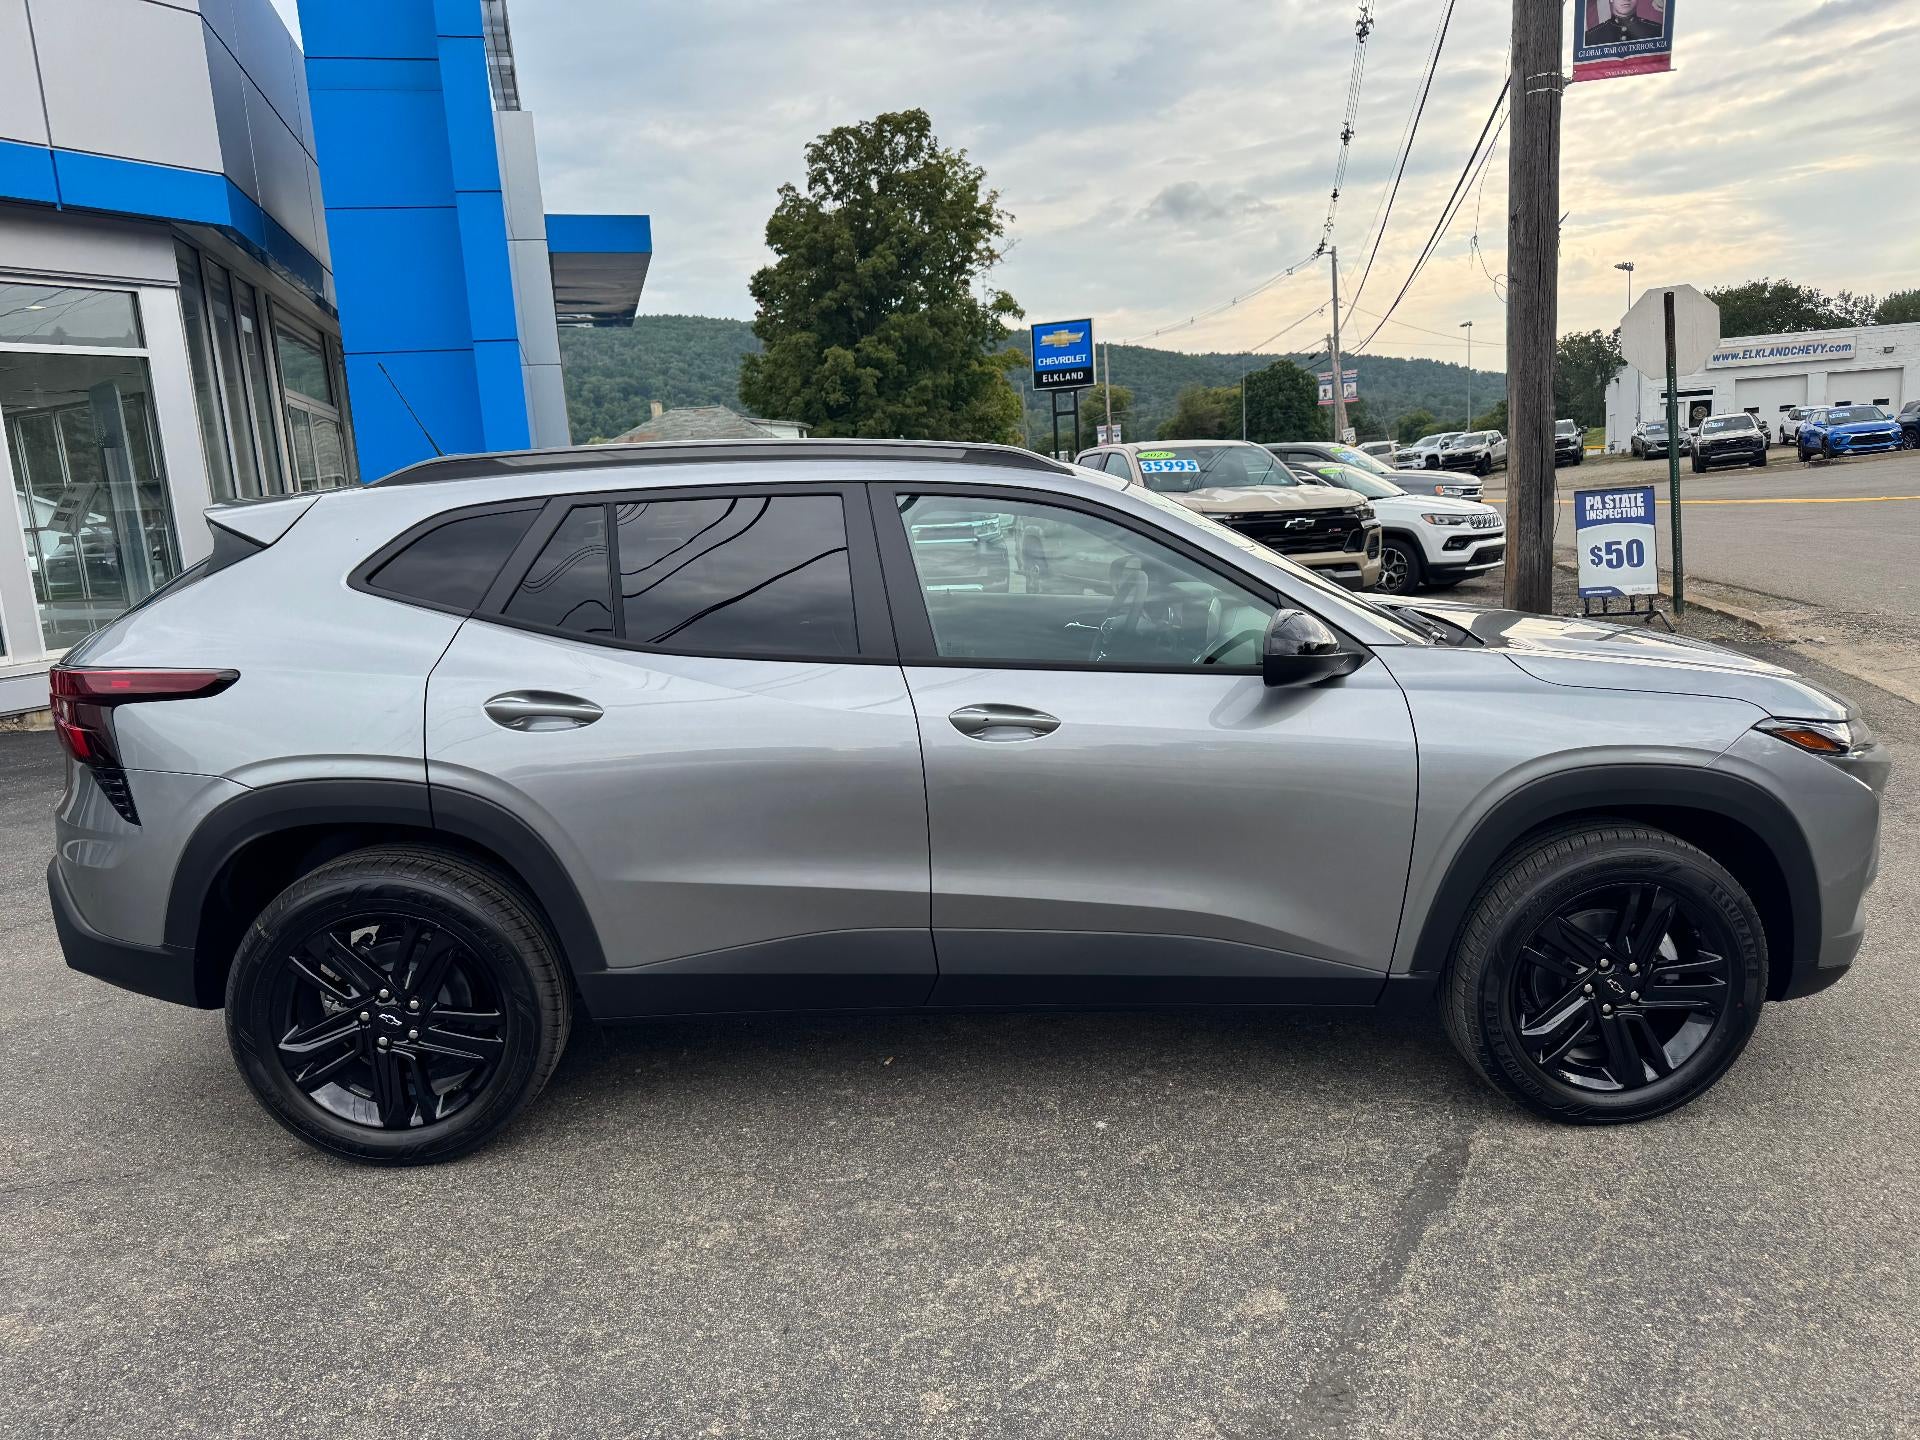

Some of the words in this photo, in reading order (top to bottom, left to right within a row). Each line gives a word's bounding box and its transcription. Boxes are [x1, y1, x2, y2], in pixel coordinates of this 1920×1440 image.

[1578, 49, 1602, 58] GLOBAL
[1603, 46, 1617, 54] WAR
[1617, 45, 1628, 53] ON
[1712, 343, 1852, 362] www.ELKLANDCHEVY.com
[1038, 354, 1087, 366] CHEVROLET
[1042, 371, 1084, 383] ELKLAND
[1142, 460, 1196, 472] 35995
[1585, 495, 1603, 511] PA
[1604, 492, 1645, 509] STATE
[1585, 506, 1645, 521] INSPECTION
[1589, 538, 1645, 569] $50
